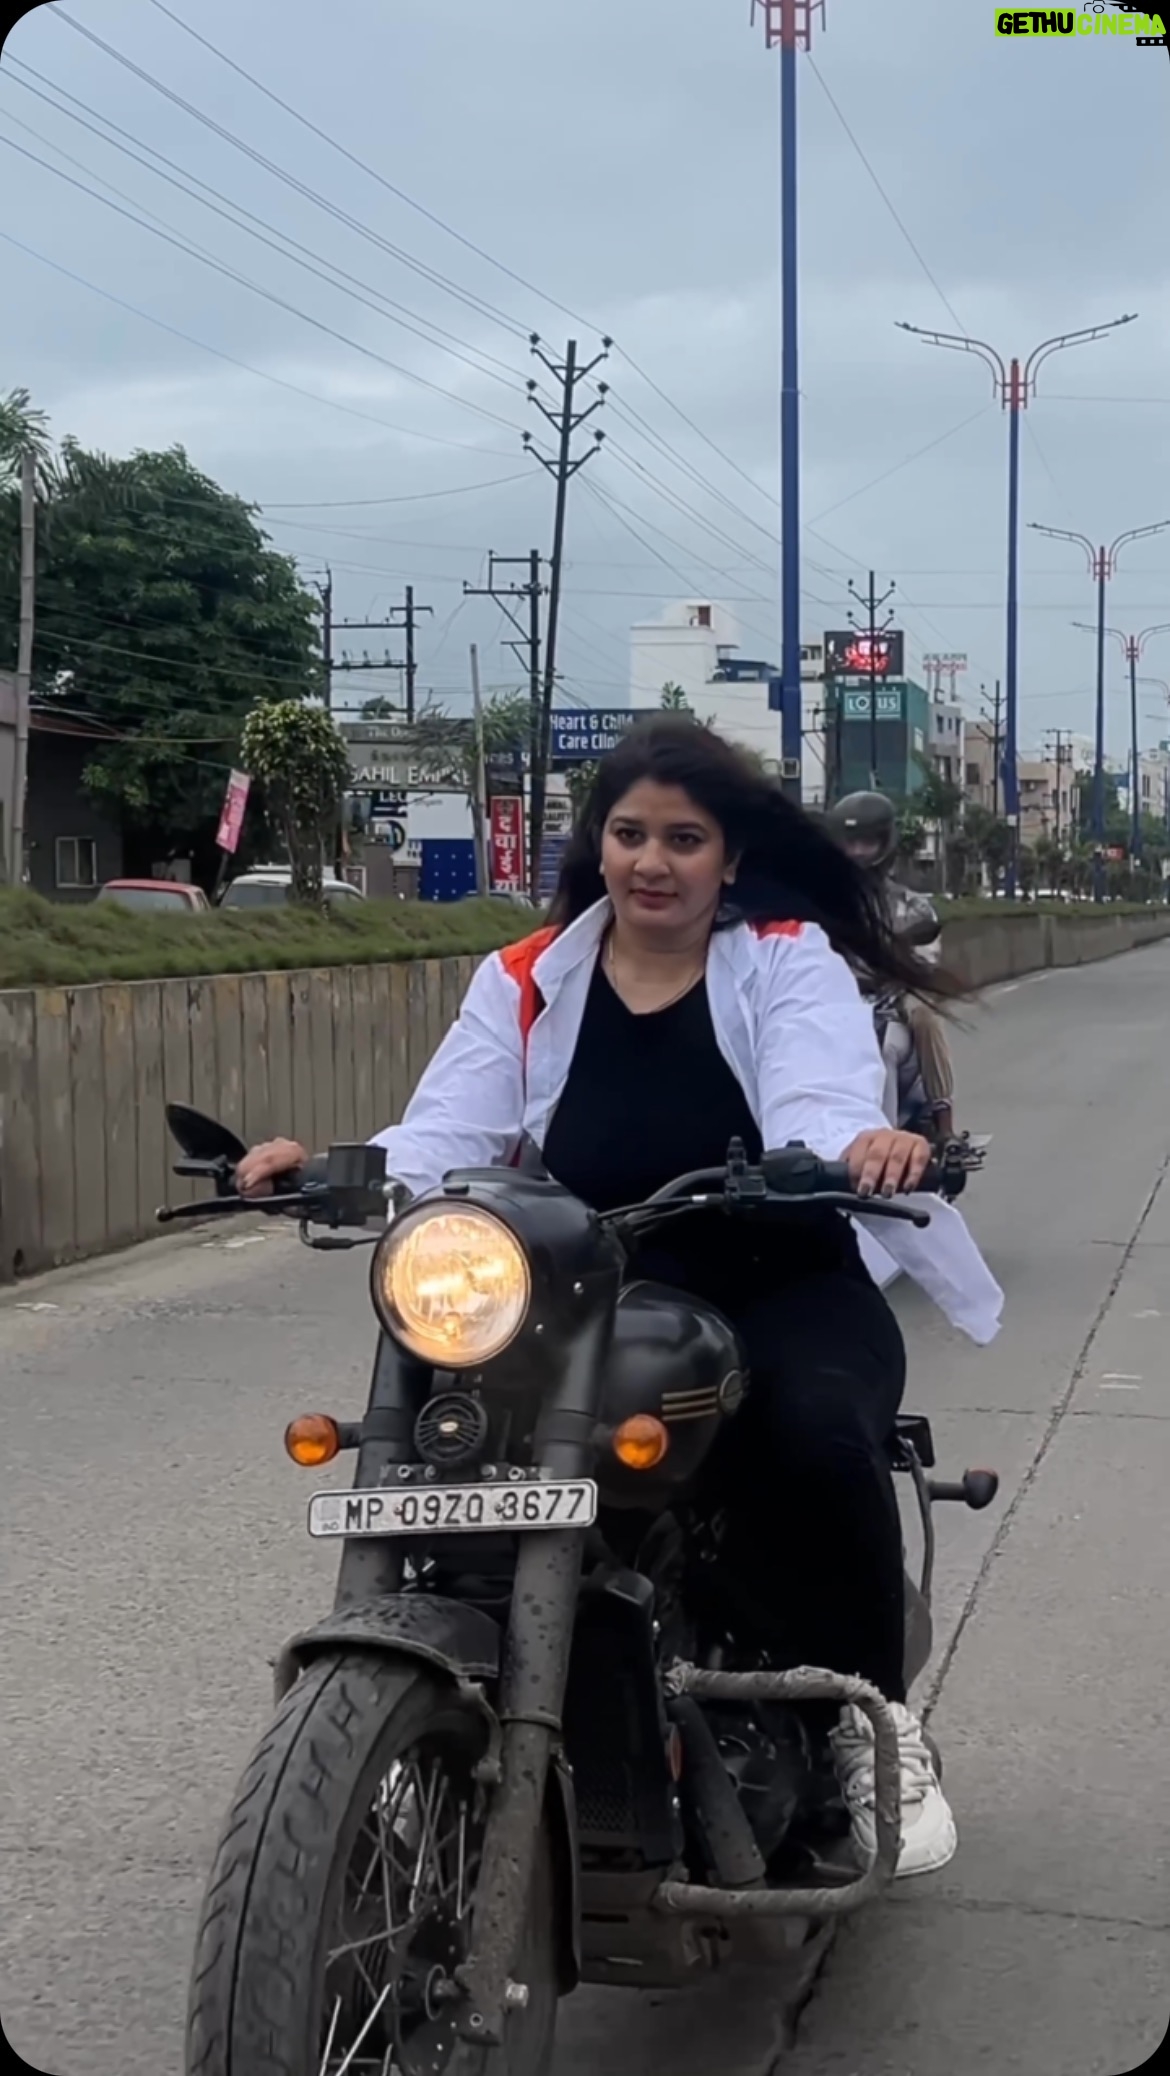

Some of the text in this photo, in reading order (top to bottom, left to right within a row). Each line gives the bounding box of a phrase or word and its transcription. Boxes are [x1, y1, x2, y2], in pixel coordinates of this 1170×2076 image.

[848, 697, 897, 710] LOUS
[550, 714, 587, 731] Heart
[558, 734, 588, 750] Care
[345, 1497, 384, 1530] MP
[501, 1488, 585, 1521] 3677
